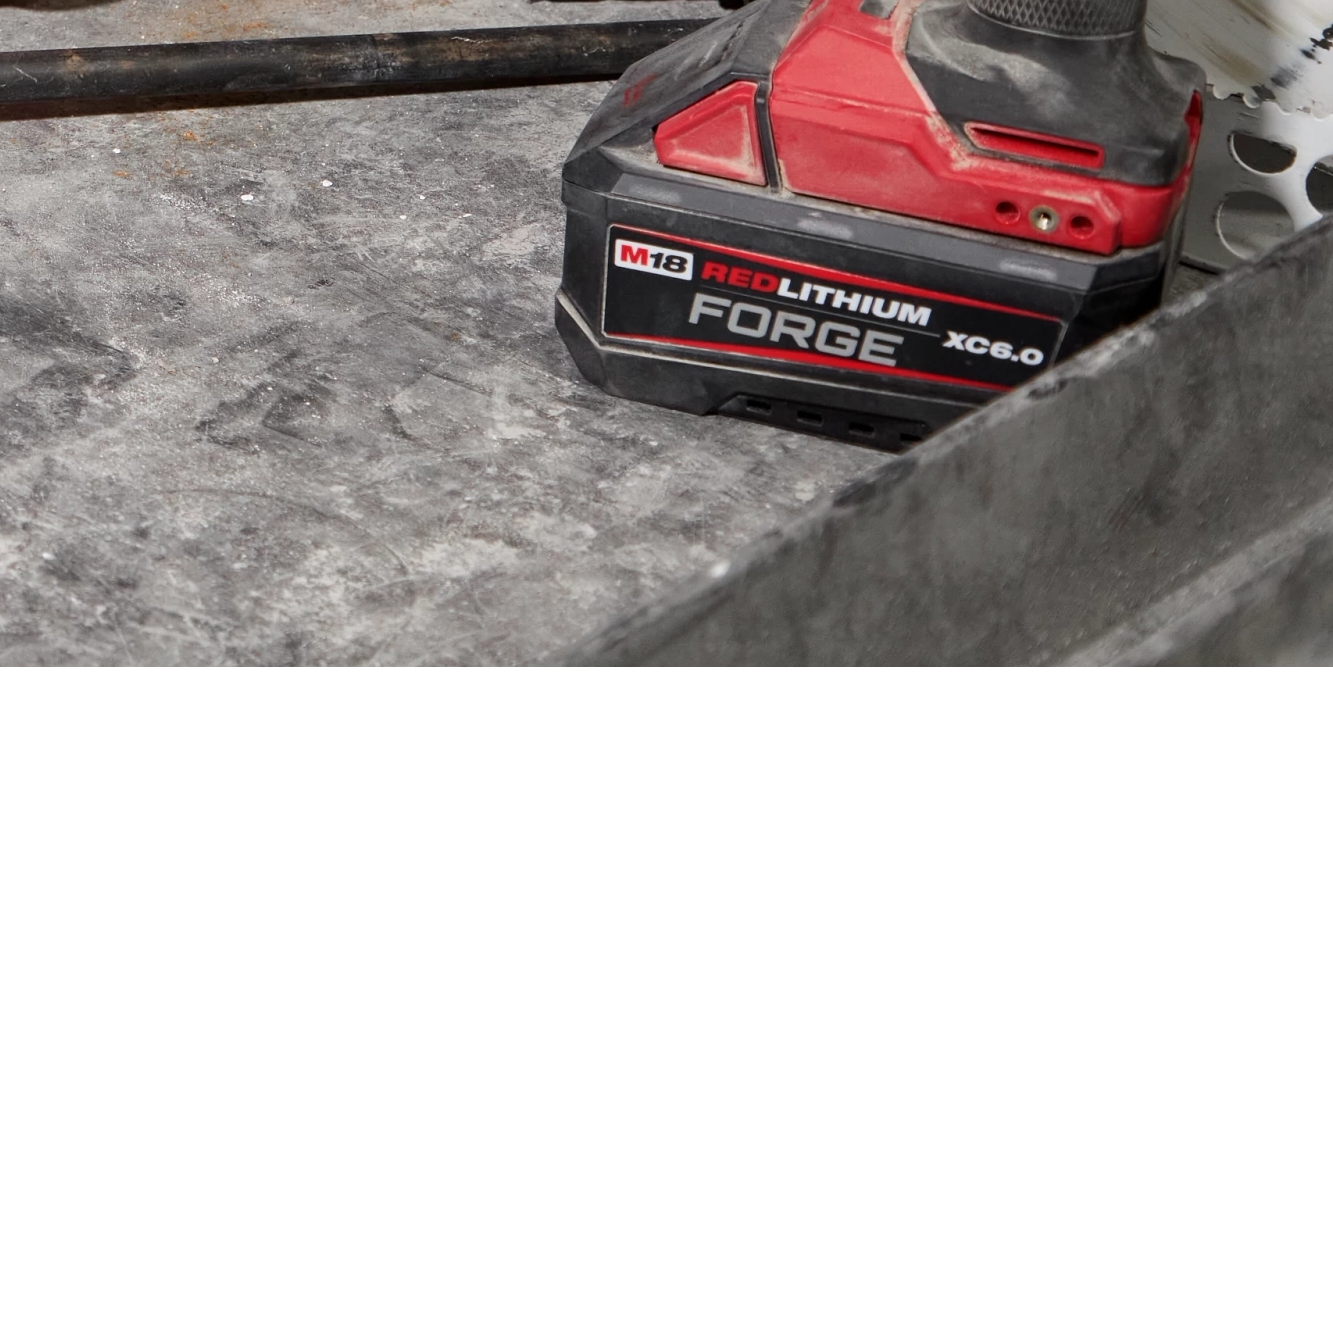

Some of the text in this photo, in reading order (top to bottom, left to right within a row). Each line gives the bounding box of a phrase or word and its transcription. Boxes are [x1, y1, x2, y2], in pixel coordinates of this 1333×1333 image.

[620, 244, 933, 327] M18 REDLITHIUM
[688, 291, 904, 368] FORGE
[942, 331, 1045, 367] XC6.0
